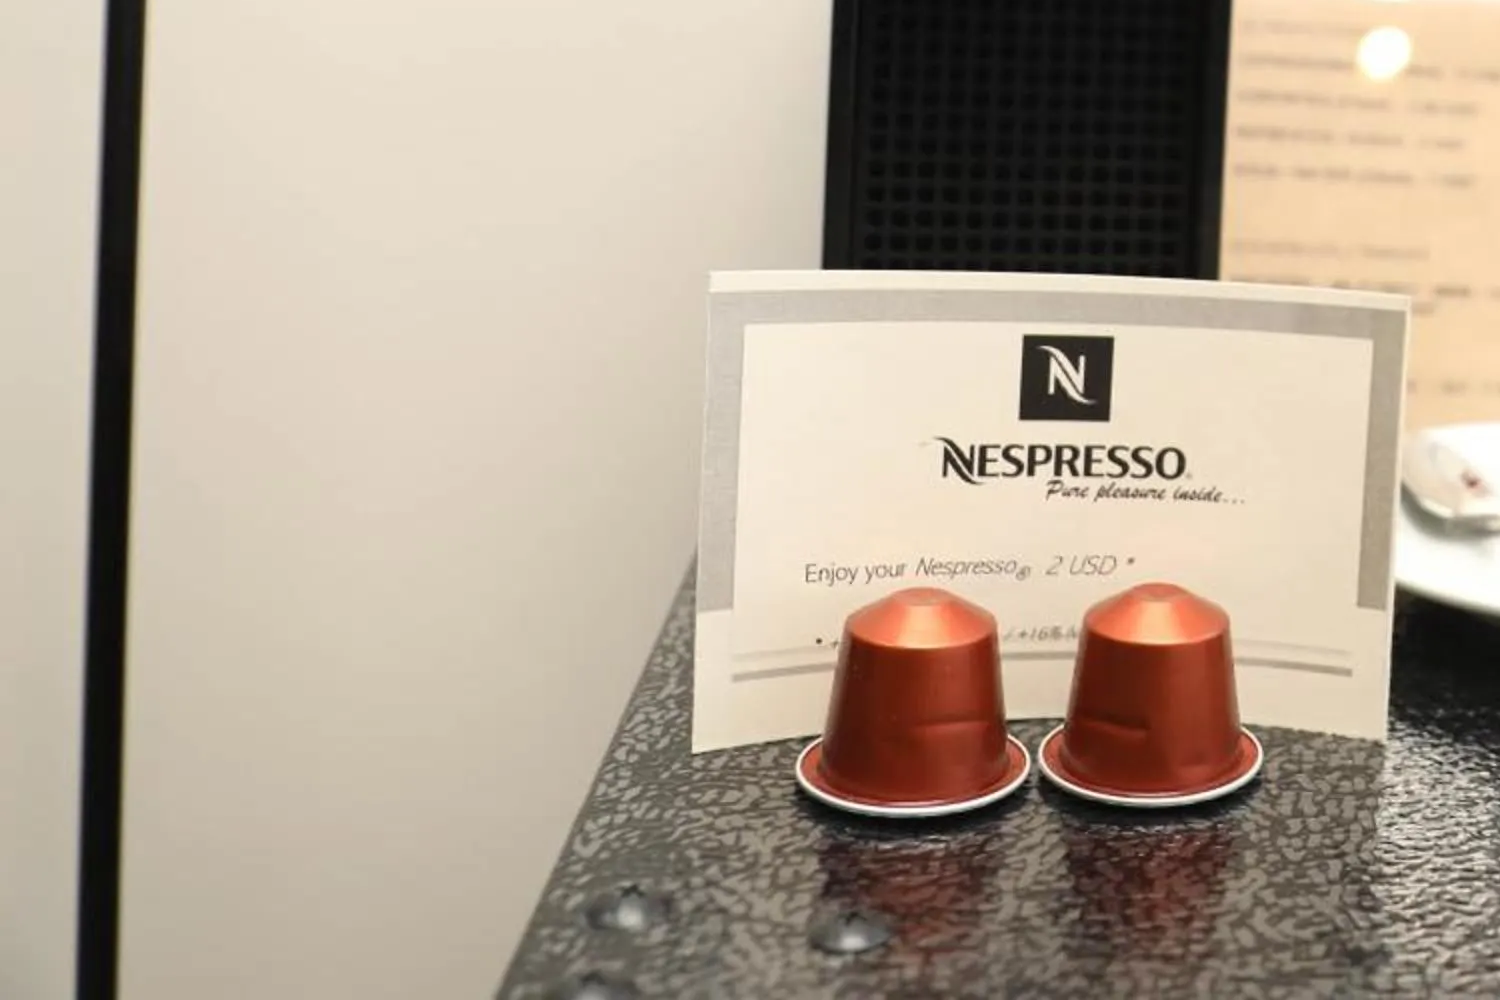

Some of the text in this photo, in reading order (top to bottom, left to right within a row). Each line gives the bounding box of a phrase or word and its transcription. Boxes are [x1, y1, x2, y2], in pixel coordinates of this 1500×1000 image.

[1036, 344, 1098, 405] N
[932, 437, 1188, 485] NESPRESSO
[1045, 479, 1090, 501] Pure
[1093, 482, 1166, 503] pleasure
[804, 563, 859, 587] Enjoy
[864, 563, 906, 585] your
[1045, 555, 1064, 577] 2
[1069, 554, 1118, 577] USD
